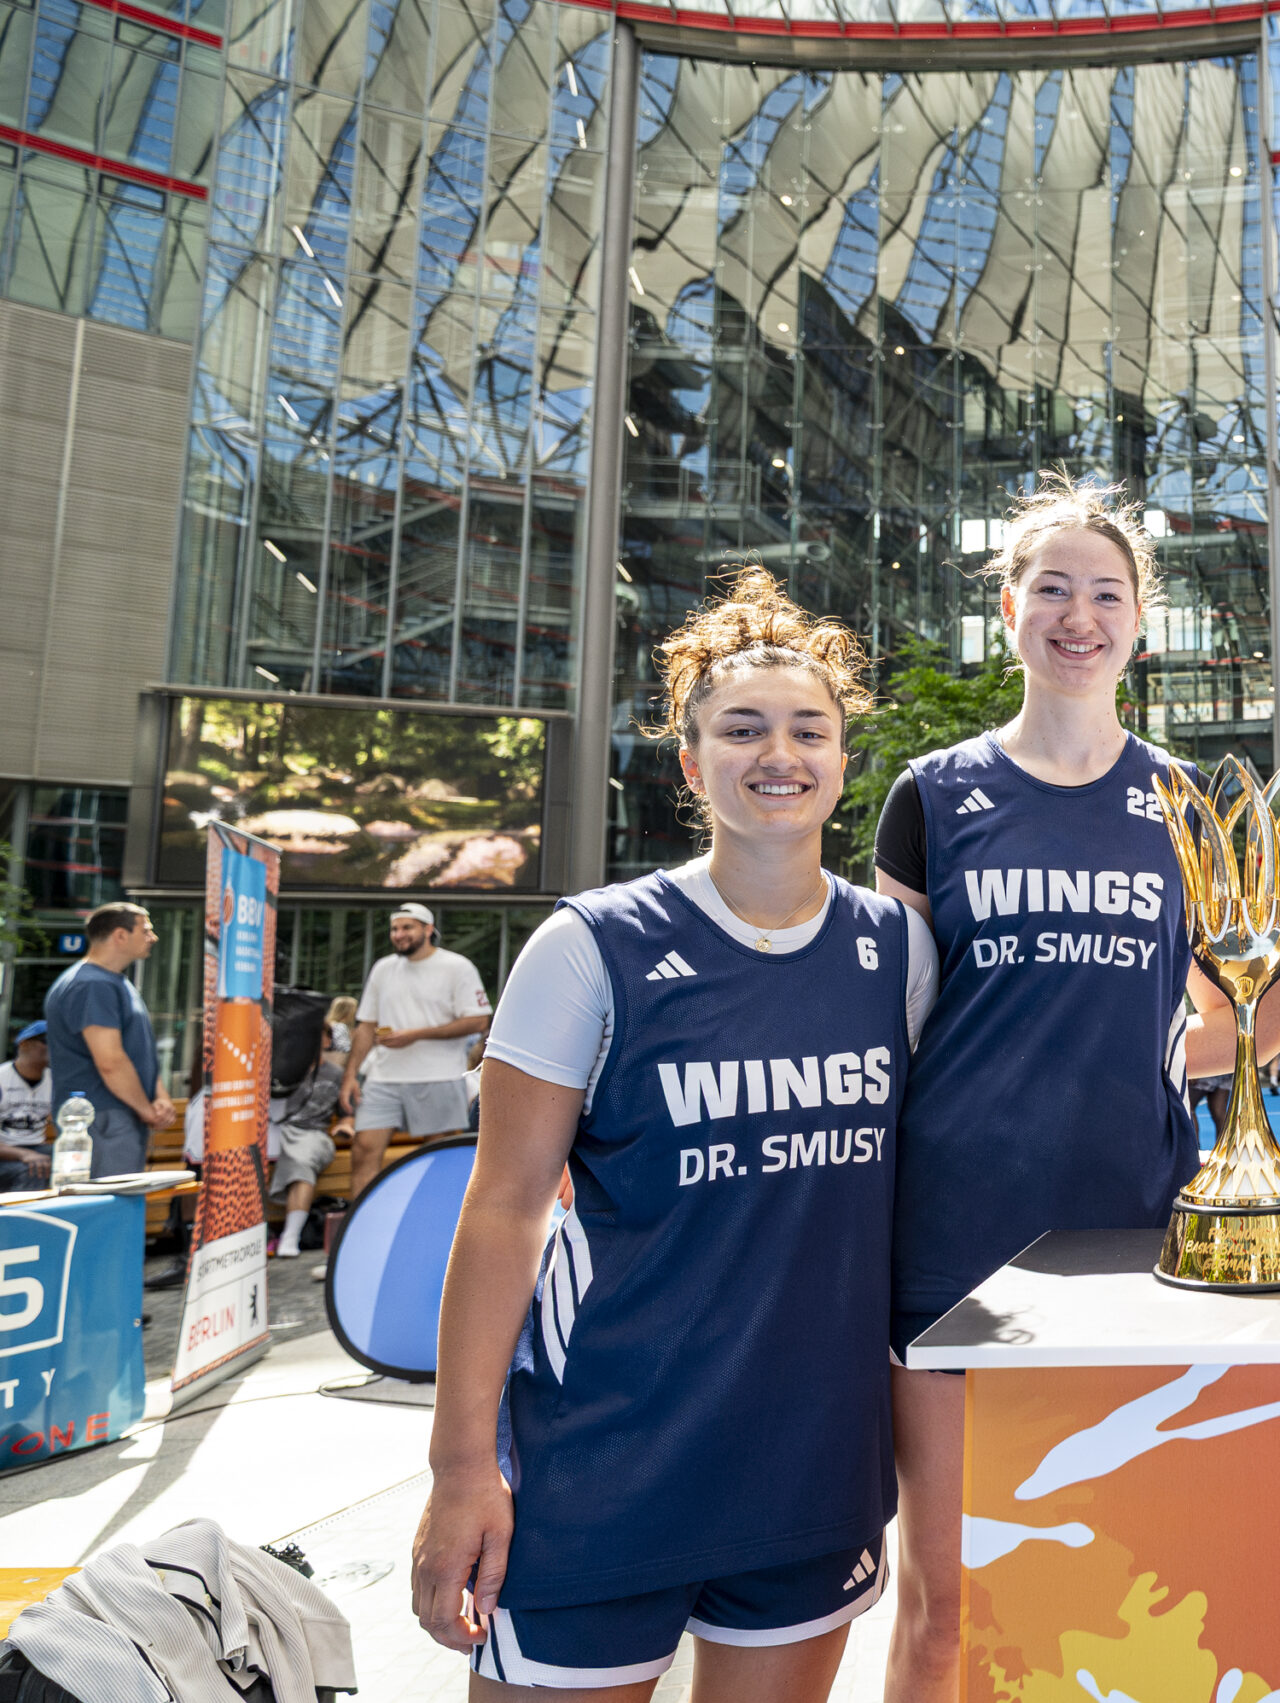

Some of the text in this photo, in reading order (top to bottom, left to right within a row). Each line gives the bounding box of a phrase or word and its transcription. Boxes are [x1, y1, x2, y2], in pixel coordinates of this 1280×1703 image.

[1127, 786, 1164, 824] 22
[964, 868, 1164, 922] WINGS
[855, 936, 879, 971] 6
[972, 932, 1157, 970] DR. SMUSY
[657, 1046, 891, 1128] WINGS
[678, 1127, 886, 1186] DR. SMUSY
[187, 1303, 237, 1352] BERLIN
